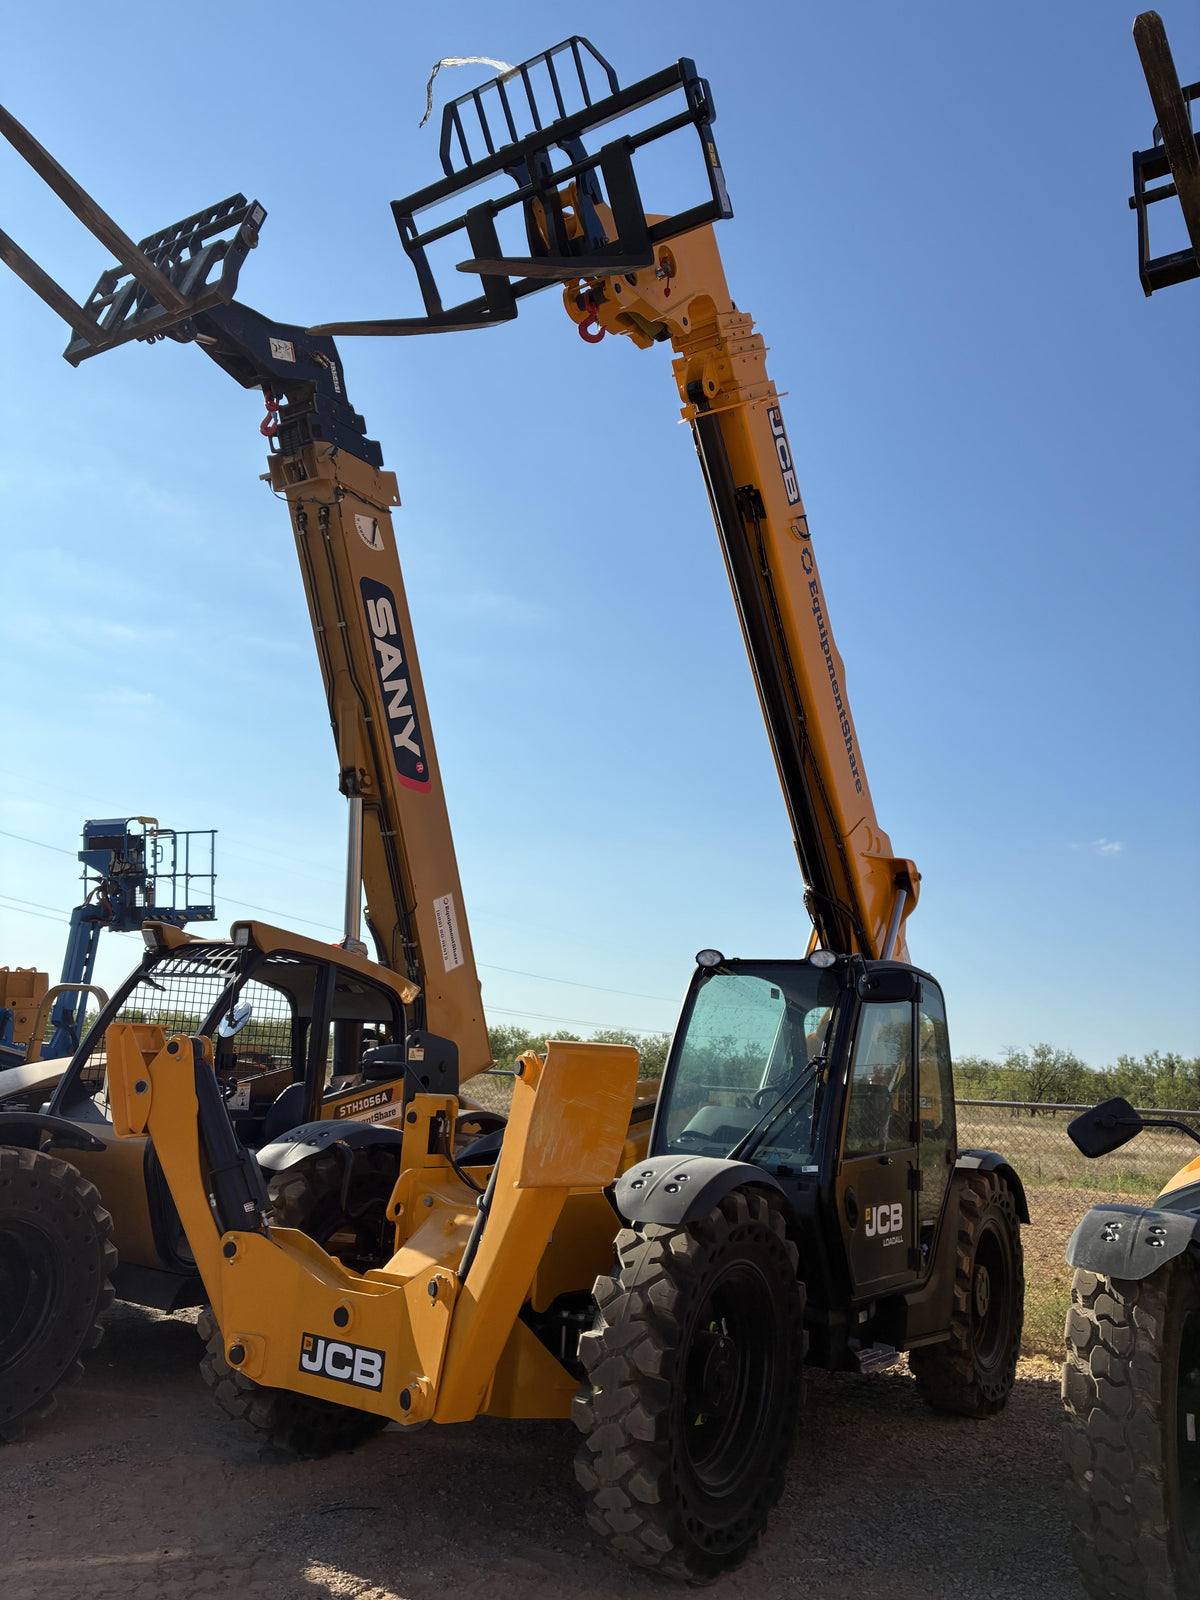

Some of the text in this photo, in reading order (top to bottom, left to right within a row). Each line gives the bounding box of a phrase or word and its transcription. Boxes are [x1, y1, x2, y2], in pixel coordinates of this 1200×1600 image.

[769, 410, 800, 503] JCB
[367, 597, 421, 758] SANY
[808, 578, 863, 795] EquipmentShare
[340, 1092, 388, 1117] STH1056A
[361, 1108, 397, 1124] entShare
[865, 1203, 903, 1237] JCB
[302, 1339, 382, 1387] JCB
